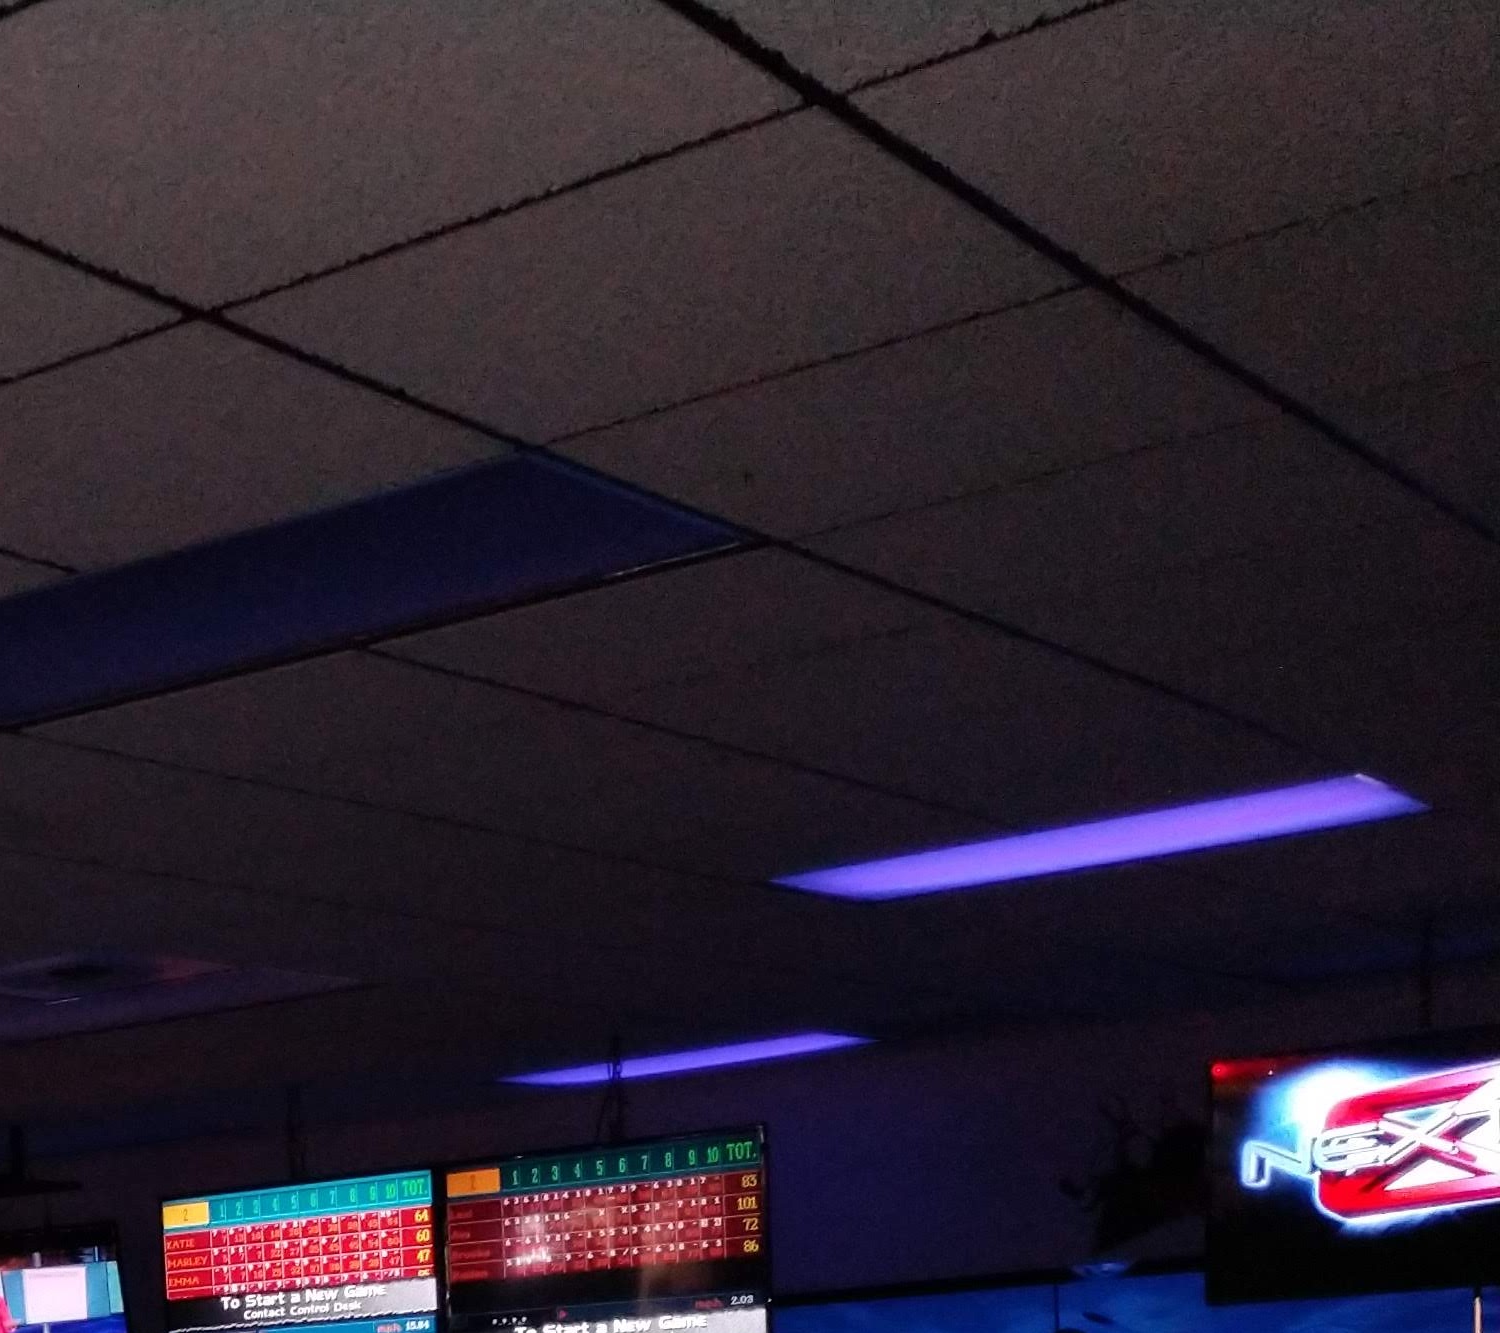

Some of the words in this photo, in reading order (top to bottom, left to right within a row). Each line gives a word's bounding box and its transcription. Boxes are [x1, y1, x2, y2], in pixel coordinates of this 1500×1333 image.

[532, 1168, 539, 1183] 2
[551, 1166, 559, 1180] 3
[596, 1160, 603, 1176] 5
[619, 1157, 626, 1173] 6
[641, 1155, 648, 1170] 7
[665, 1152, 672, 1168] 8
[688, 1150, 695, 1166] 9
[707, 1148, 719, 1164] 10
[741, 1174, 757, 1188] 83
[737, 1196, 758, 1210] 101
[414, 1208, 429, 1223] 64
[742, 1217, 759, 1231] 72
[167, 1256, 208, 1269] MARLEY
[415, 1228, 430, 1243] 60
[743, 1239, 759, 1253] 86
[416, 1249, 431, 1264] 47
[220, 1296, 240, 1311] To
[245, 1293, 286, 1308] Start
[290, 1292, 300, 1303] a
[305, 1288, 338, 1303] New
[243, 1308, 285, 1321] Contact
[289, 1304, 329, 1316] Control
[333, 1301, 362, 1313] Desk
[613, 1318, 652, 1333] New
